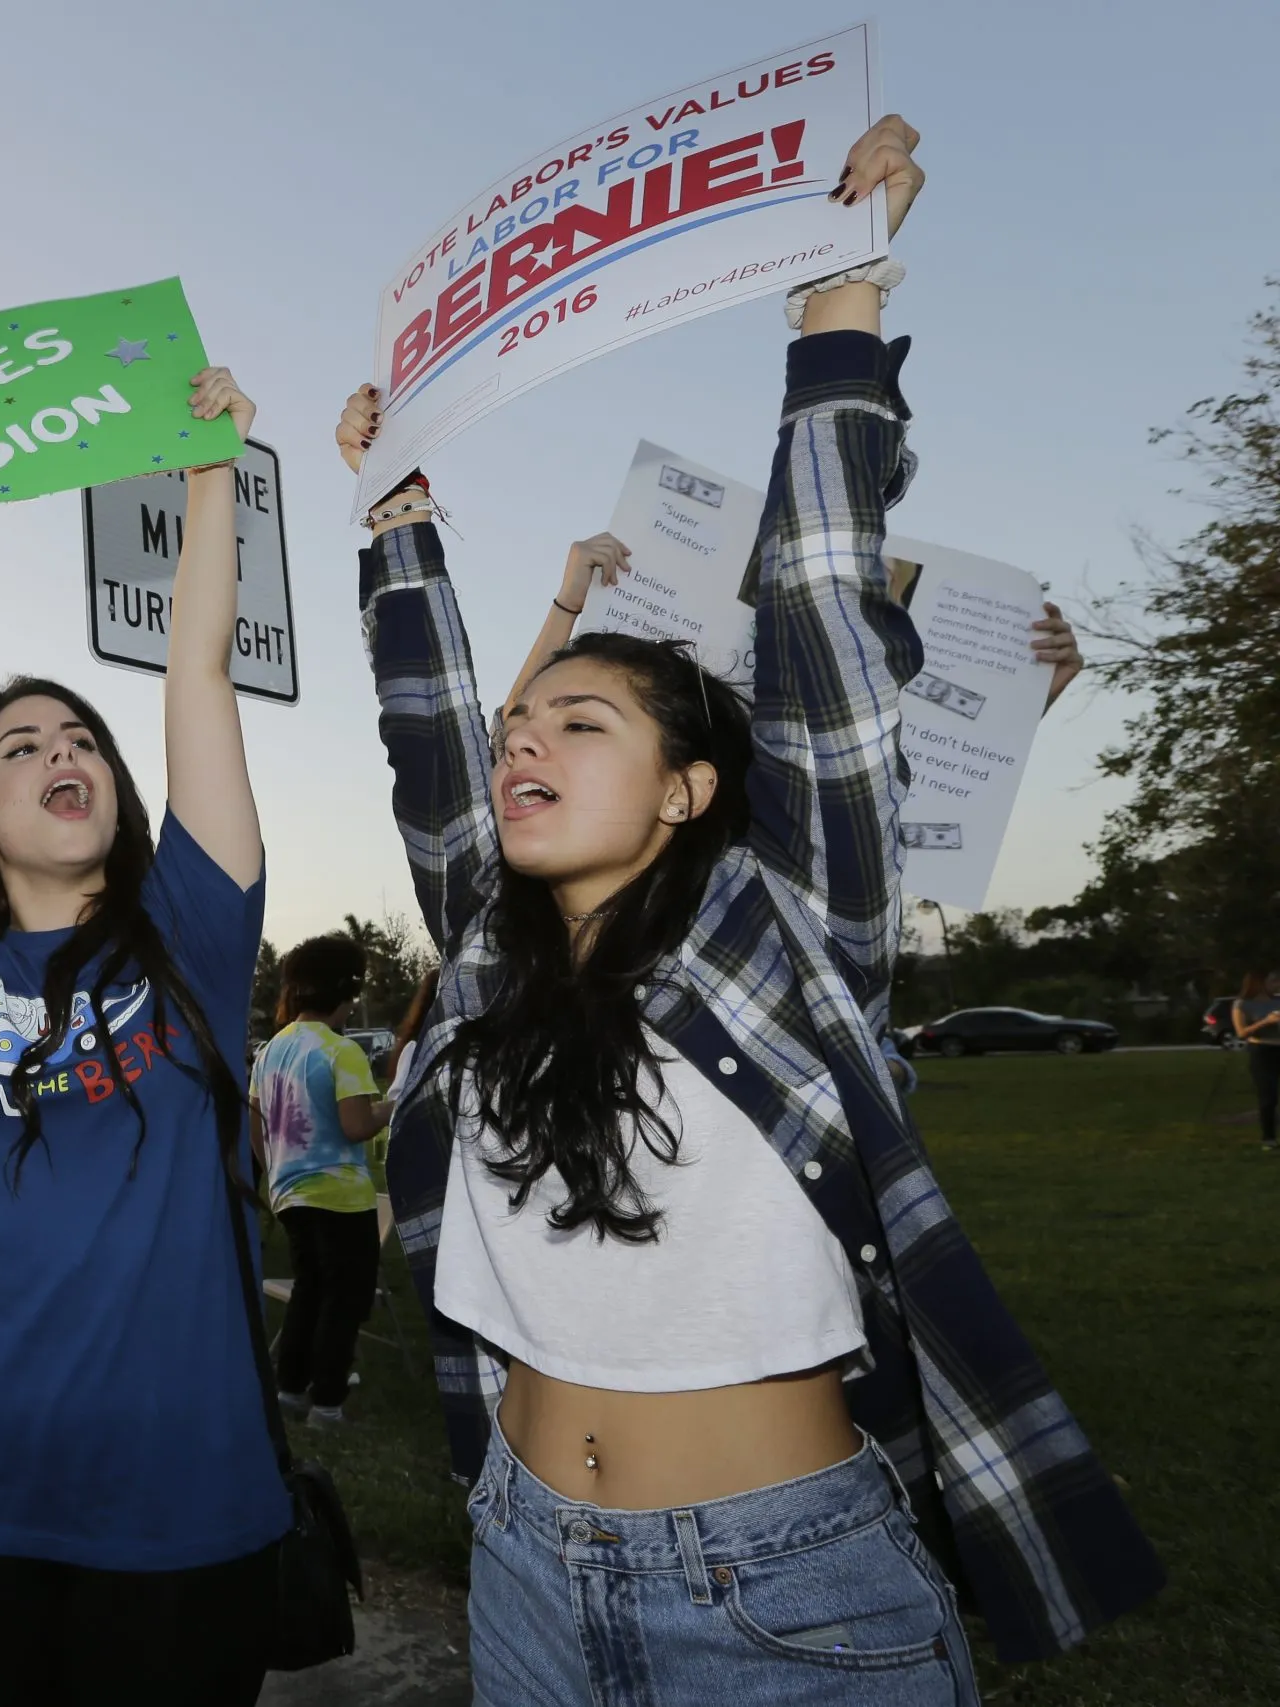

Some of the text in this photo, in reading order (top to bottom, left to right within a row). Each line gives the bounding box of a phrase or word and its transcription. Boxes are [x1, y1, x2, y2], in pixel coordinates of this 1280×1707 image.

[393, 52, 836, 304] VOTE LABOR'S VALUES
[447, 128, 700, 280] LABOR FOR
[389, 119, 806, 398] BERNIE!
[624, 243, 834, 321] #Labor4Bernie
[497, 284, 598, 357] 2016
[634, 570, 677, 599] believe
[102, 578, 285, 665] TUR GHT
[606, 605, 631, 622] just
[631, 618, 639, 627] a
[613, 587, 703, 633] marriage is not
[920, 728, 958, 749] don't
[961, 740, 1015, 766] believe
[925, 754, 958, 772] ever
[962, 764, 990, 782] lied
[928, 779, 972, 799] never
[30, 1071, 69, 1097] HE
